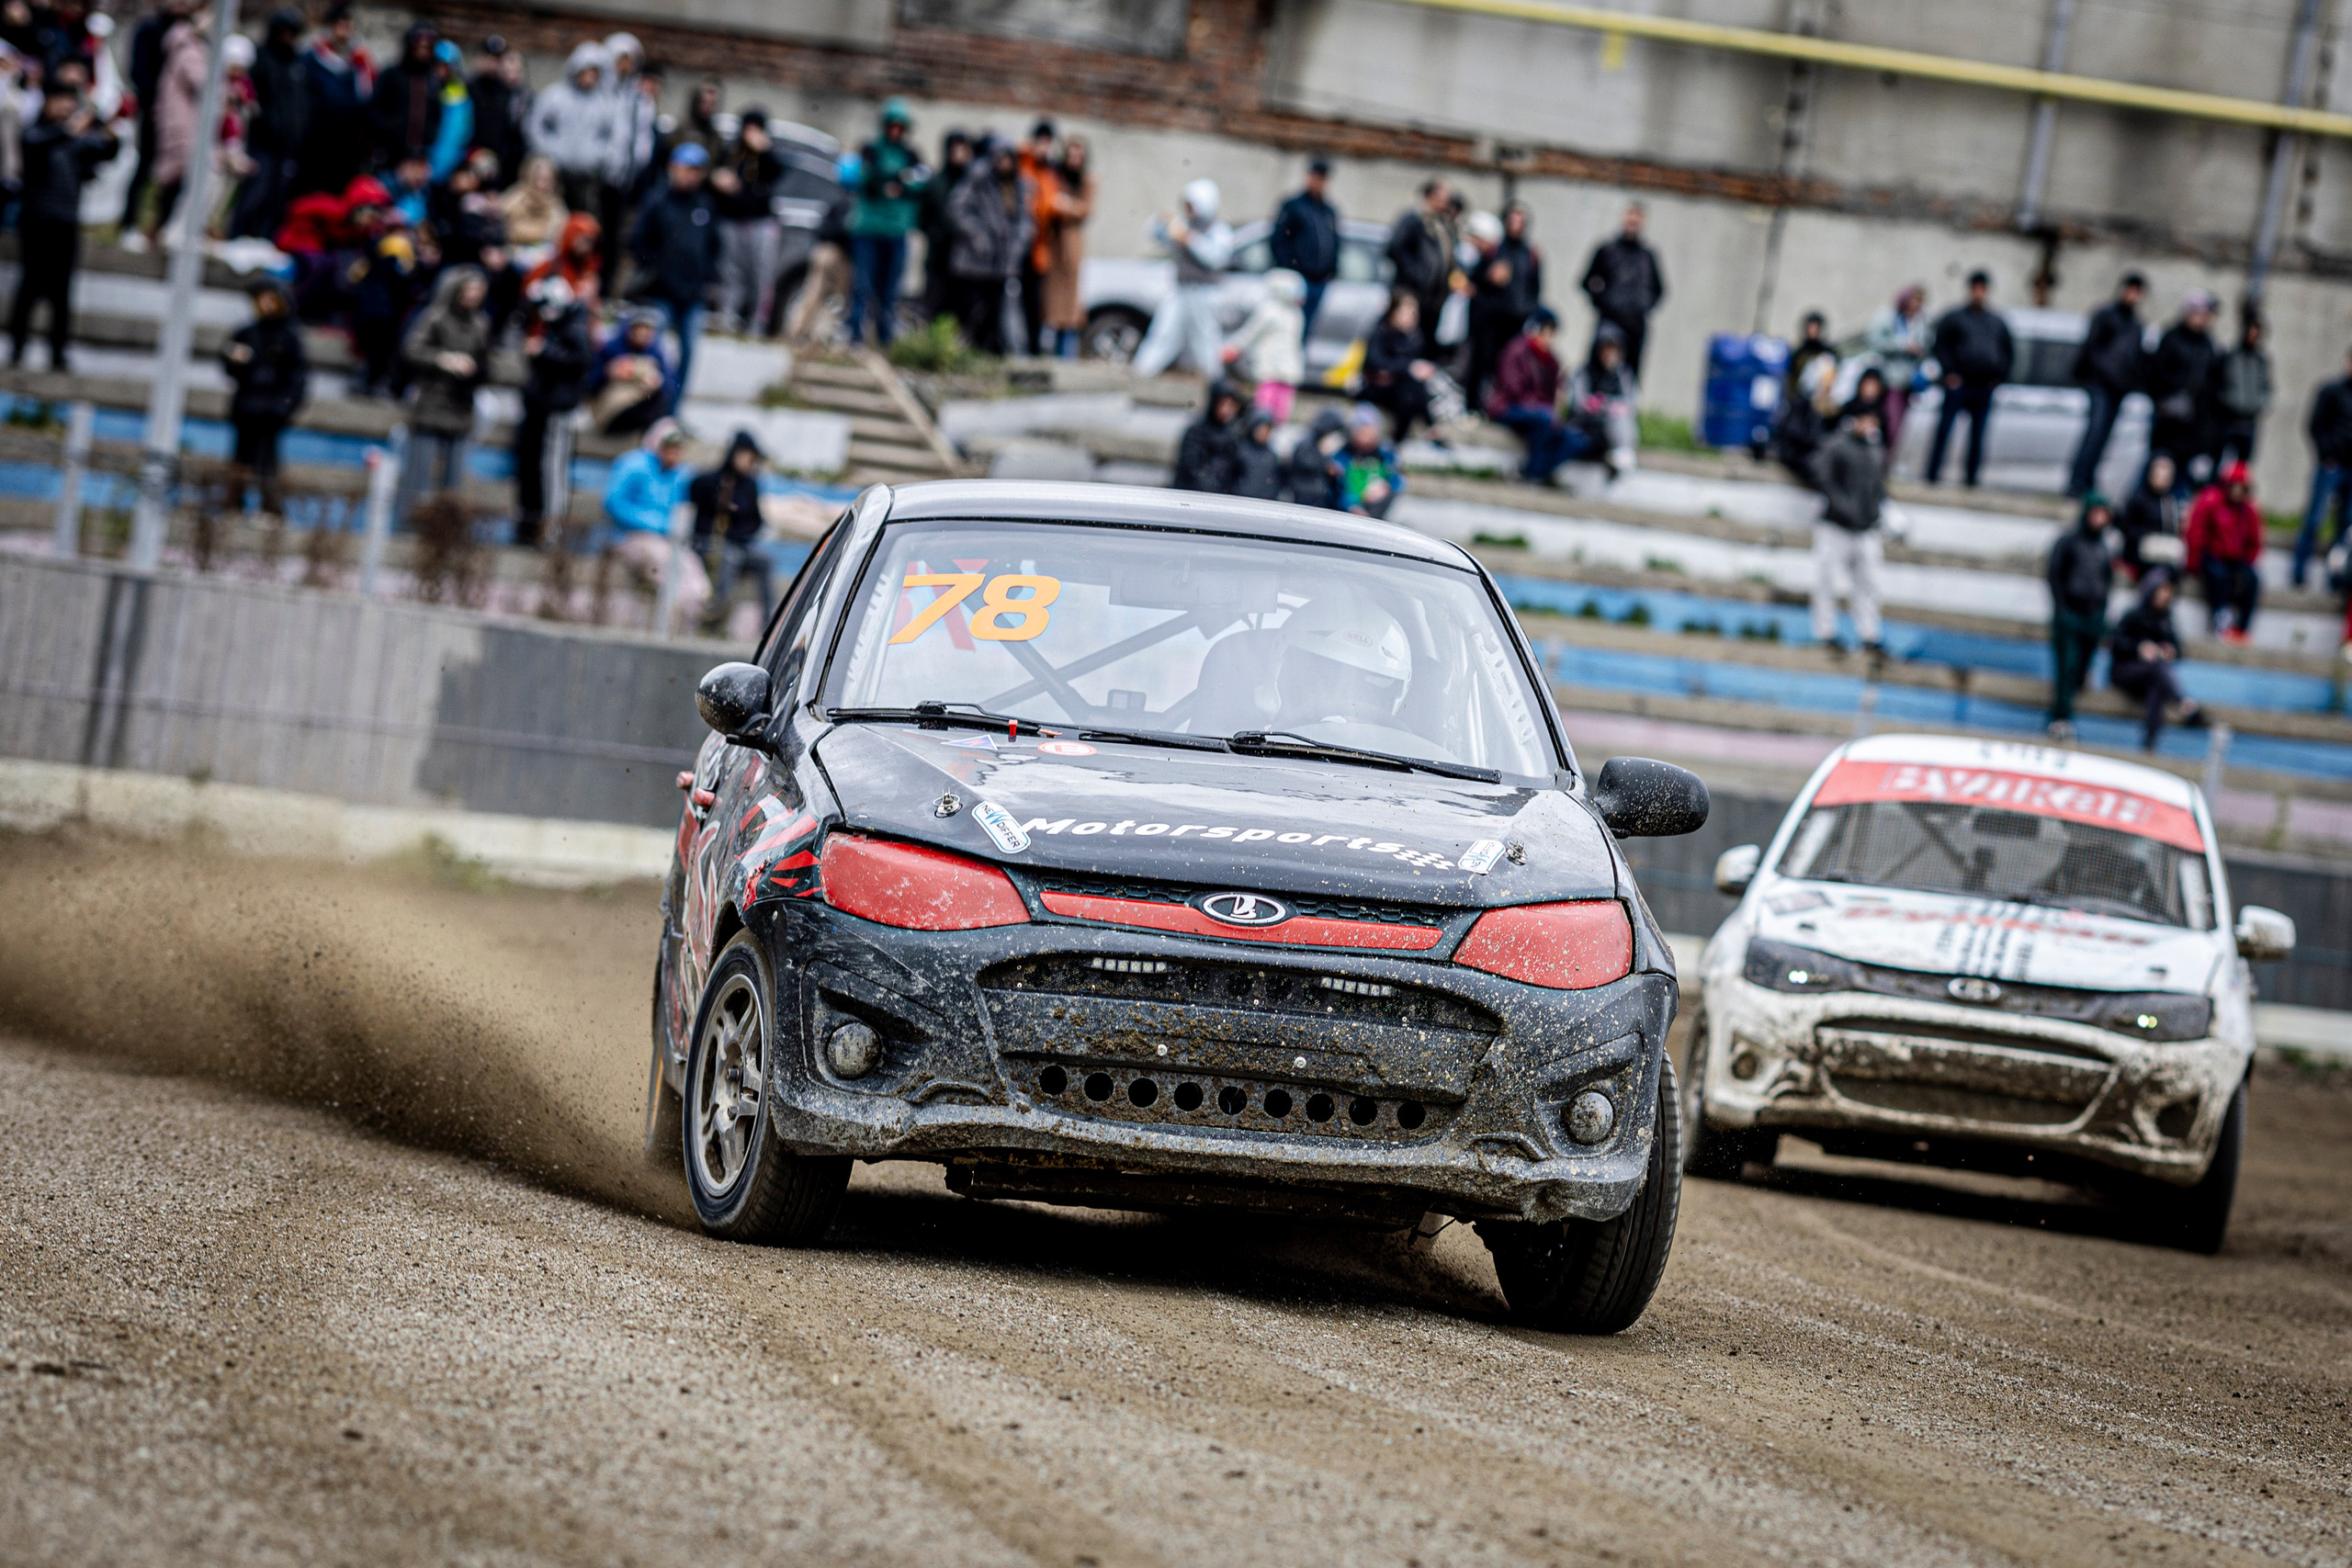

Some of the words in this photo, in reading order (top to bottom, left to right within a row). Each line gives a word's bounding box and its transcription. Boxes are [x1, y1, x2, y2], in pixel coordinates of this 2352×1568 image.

[888, 573, 1062, 645] 78
[996, 821, 1021, 848] DIFFER
[1021, 817, 1407, 853] Motorsports
